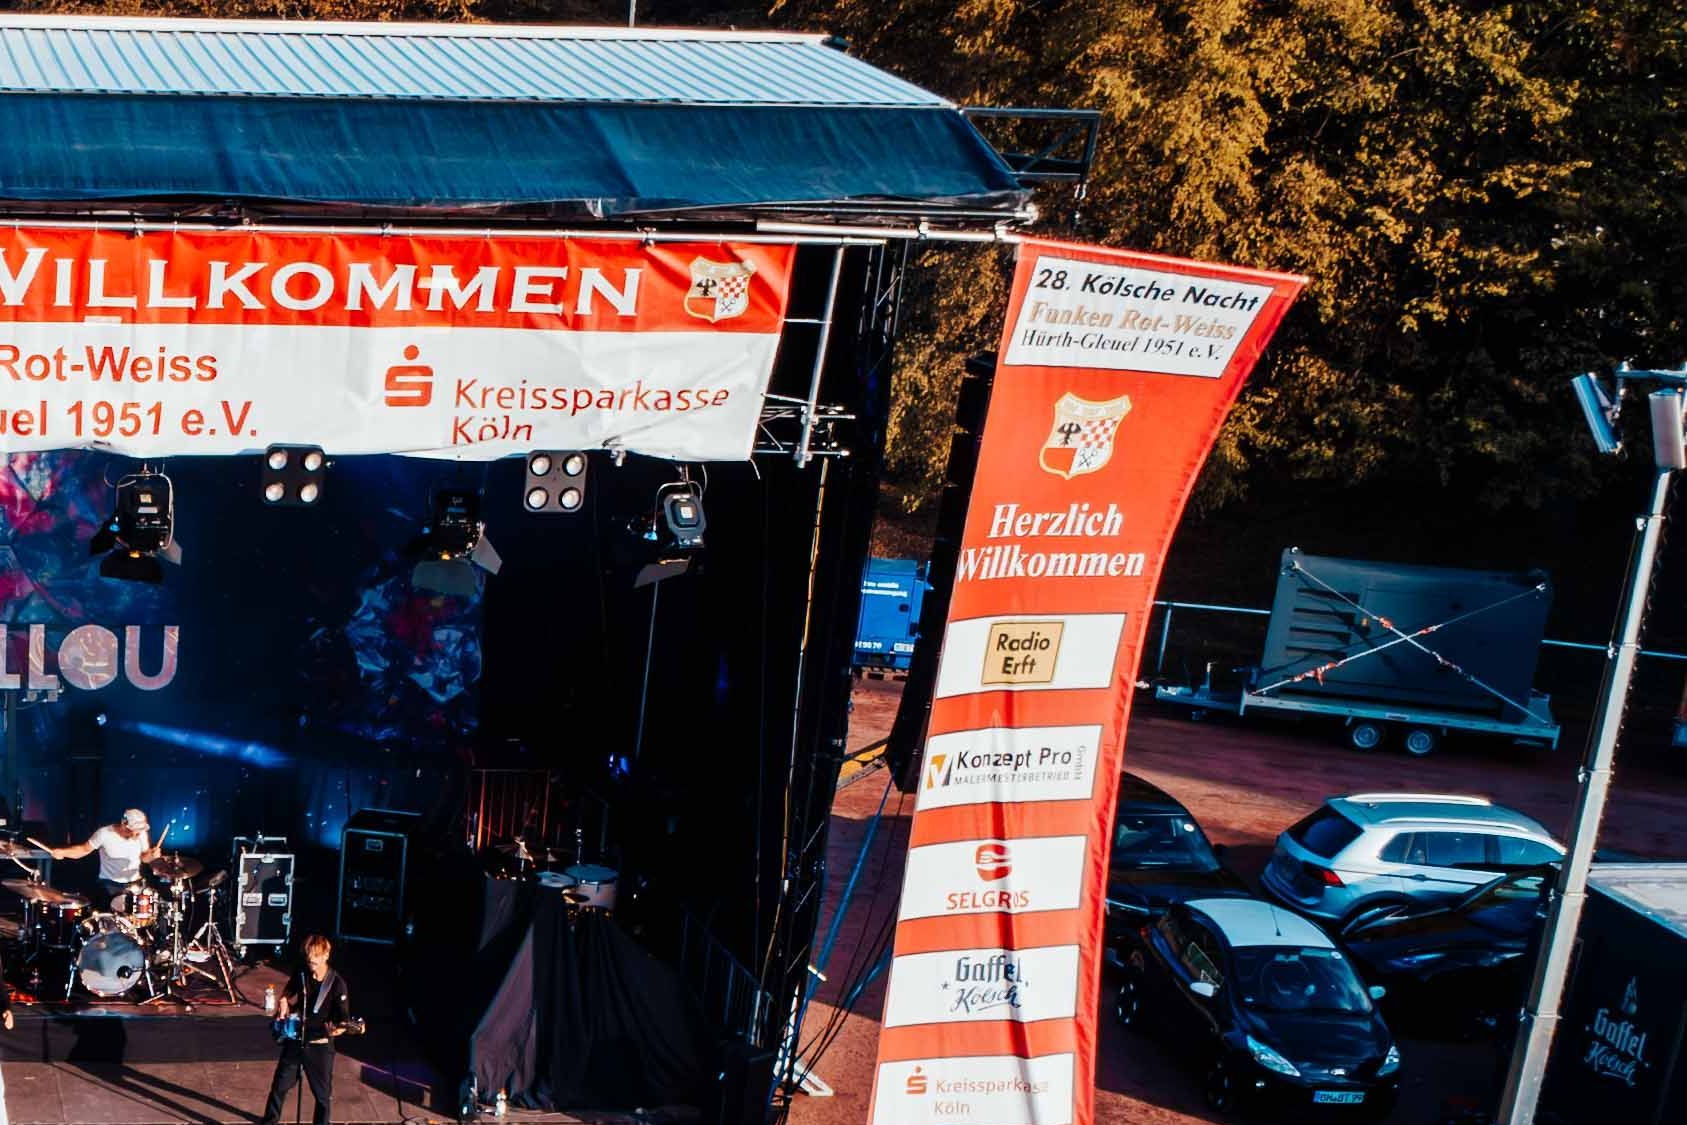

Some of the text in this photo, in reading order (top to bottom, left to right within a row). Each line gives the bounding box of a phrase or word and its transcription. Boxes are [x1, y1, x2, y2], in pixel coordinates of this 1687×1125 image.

[1034, 267, 1259, 313] 28. Kölsche Nacht
[1025, 301, 1238, 341] Funken Rot-Weiss
[1020, 328, 1220, 361] Hürth-Gleuel 1951 e.V.
[454, 378, 730, 416] Kreissparkasse
[67, 399, 164, 437] 1951
[180, 400, 258, 437] e.V.
[452, 415, 533, 445] Köln
[986, 503, 1124, 540] Herzlich
[956, 545, 1145, 583] Willkommen
[996, 630, 1051, 652] Radio
[1001, 656, 1037, 677] Erft
[956, 746, 1073, 772] Konzept Pro
[954, 954, 1023, 984] Gaffel
[933, 1100, 971, 1115] Köln
